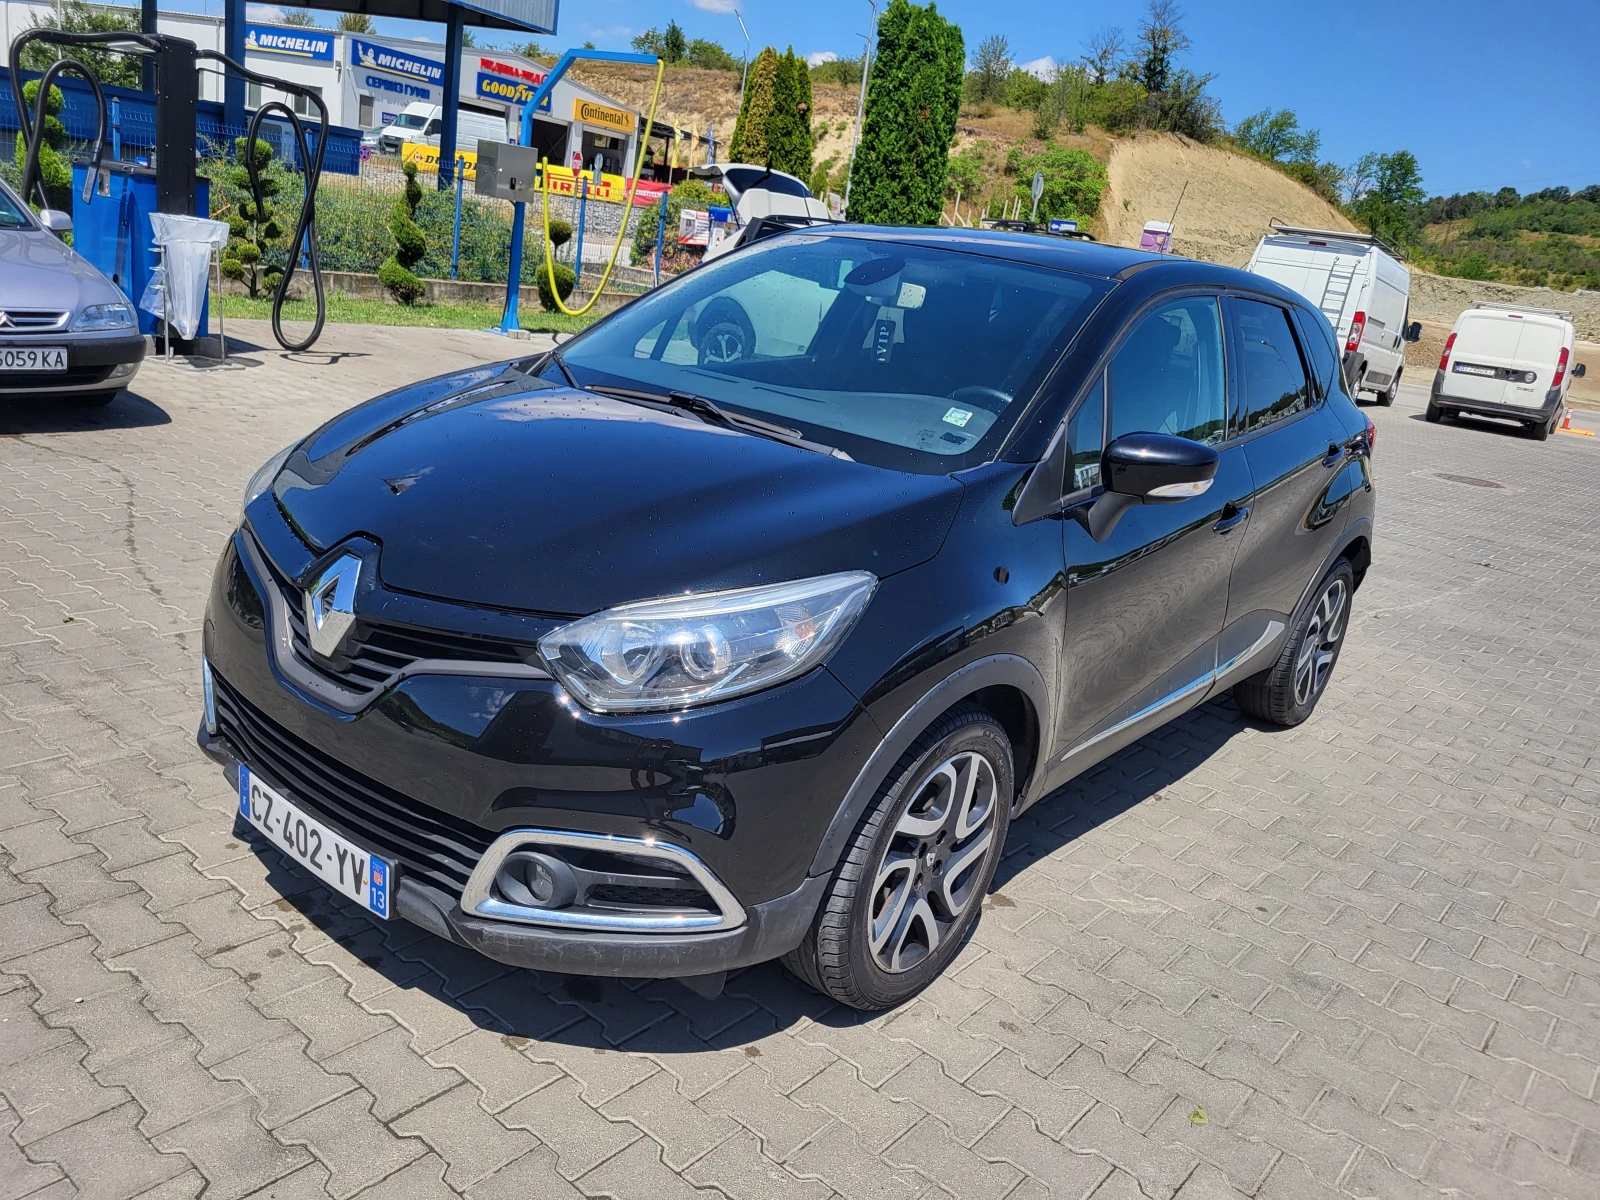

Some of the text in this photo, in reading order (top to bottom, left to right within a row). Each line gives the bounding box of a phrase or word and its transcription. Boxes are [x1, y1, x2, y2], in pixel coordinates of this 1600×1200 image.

[259, 34, 328, 54] MICHELIN
[377, 53, 442, 79] MICHELIN
[581, 103, 624, 126] Continental
[876, 326, 890, 356] VIP
[251, 784, 365, 896] CZ-402-YV
[371, 887, 385, 909] 13
